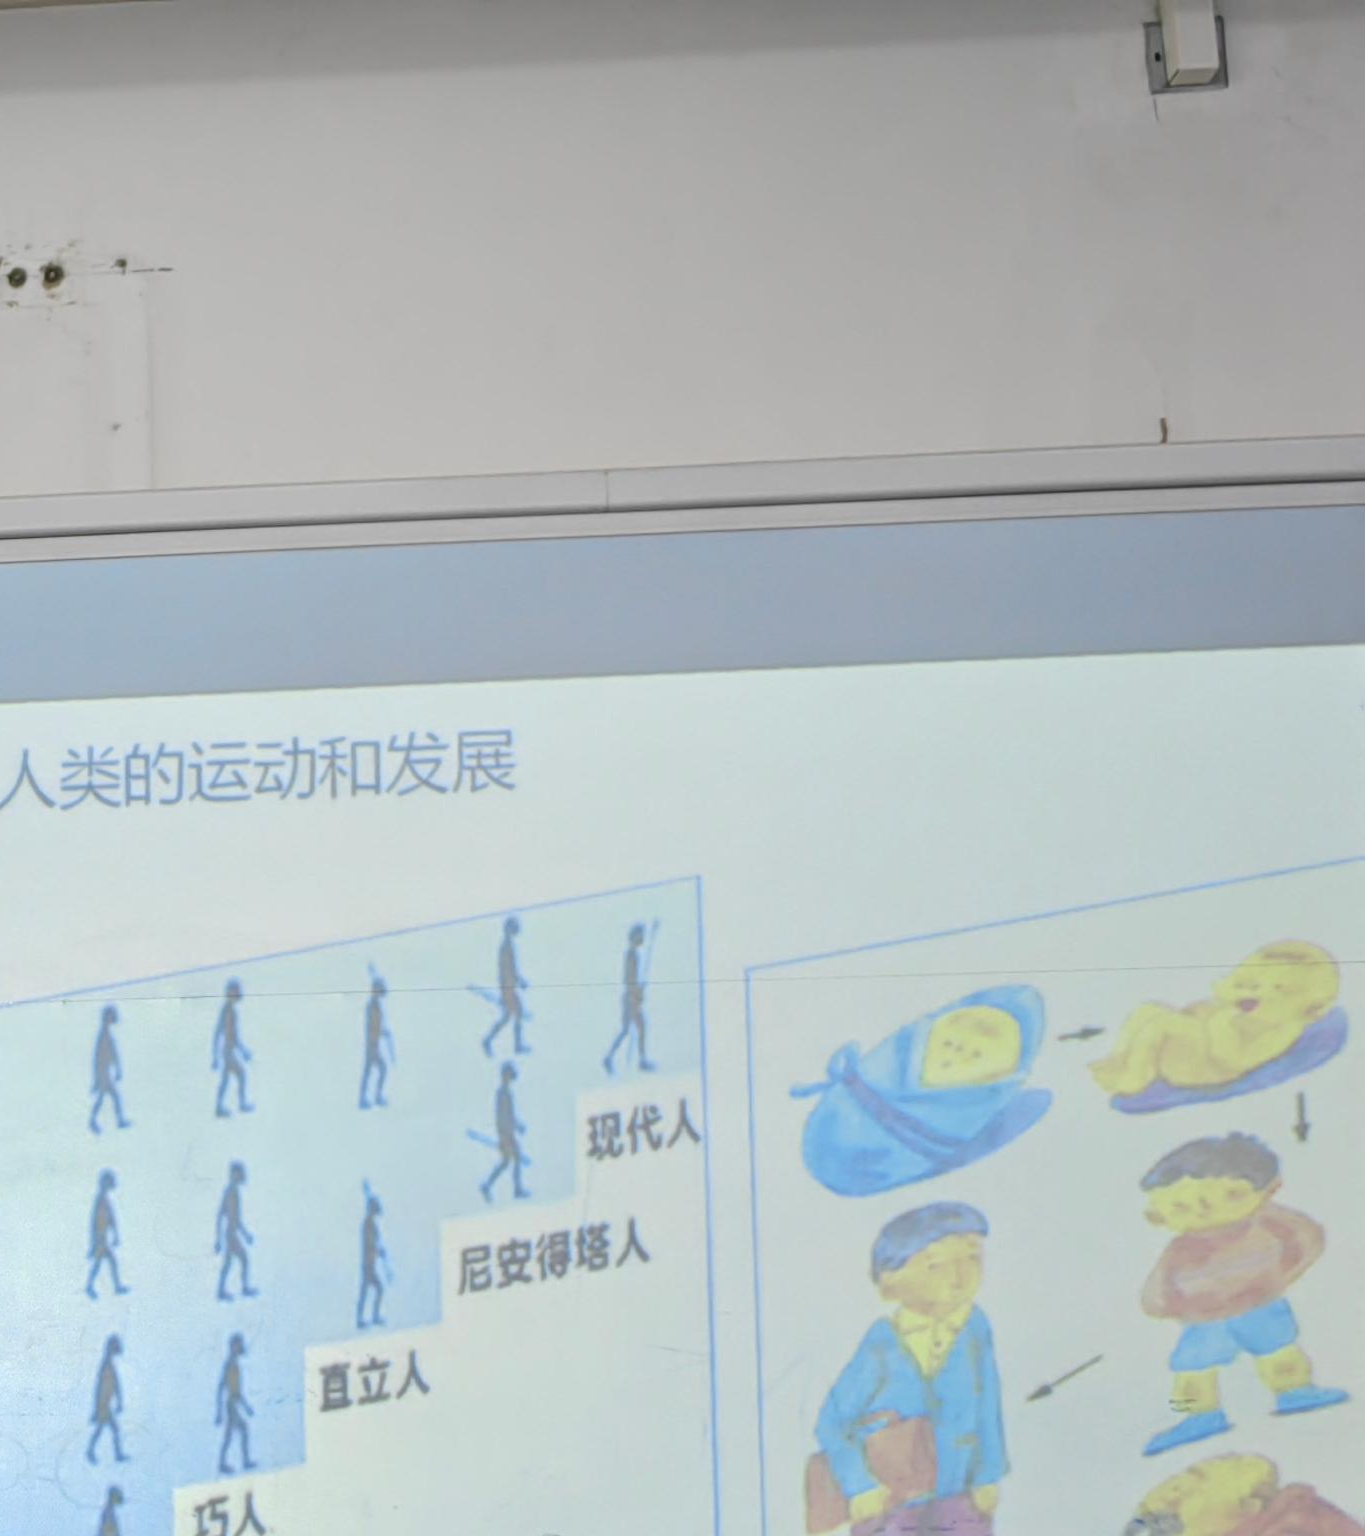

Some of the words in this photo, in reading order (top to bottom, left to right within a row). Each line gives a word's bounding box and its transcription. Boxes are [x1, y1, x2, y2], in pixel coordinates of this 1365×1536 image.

[585, 1097, 701, 1161] 现代人
[457, 1215, 651, 1297] 尼安得塔人
[318, 1348, 430, 1413] 直立人
